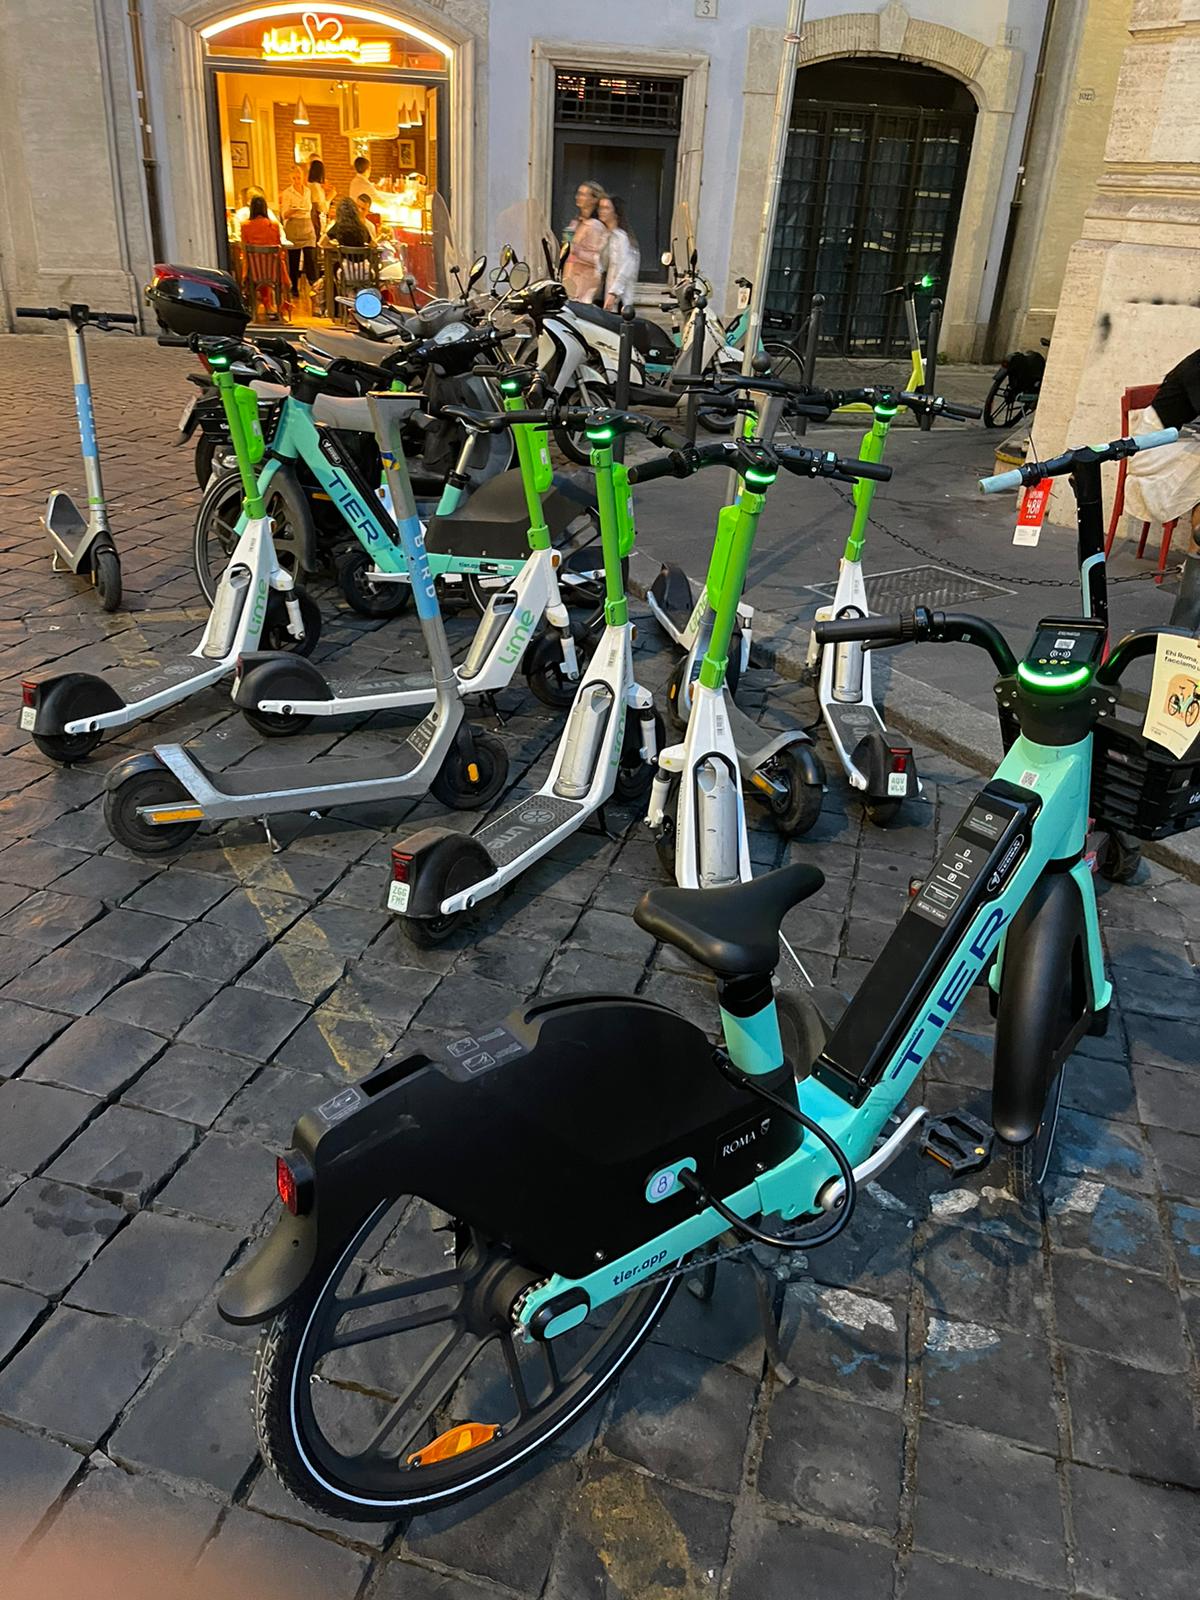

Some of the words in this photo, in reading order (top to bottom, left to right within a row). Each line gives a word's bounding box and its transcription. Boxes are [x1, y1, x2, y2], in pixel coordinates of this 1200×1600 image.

[702, 0, 711, 15] 3
[327, 469, 379, 545] TIER
[413, 536, 436, 598] BIRD
[248, 579, 268, 635] Lime
[498, 609, 535, 664] Lime
[891, 907, 1011, 1080] TIER
[722, 1131, 756, 1157] ROMA
